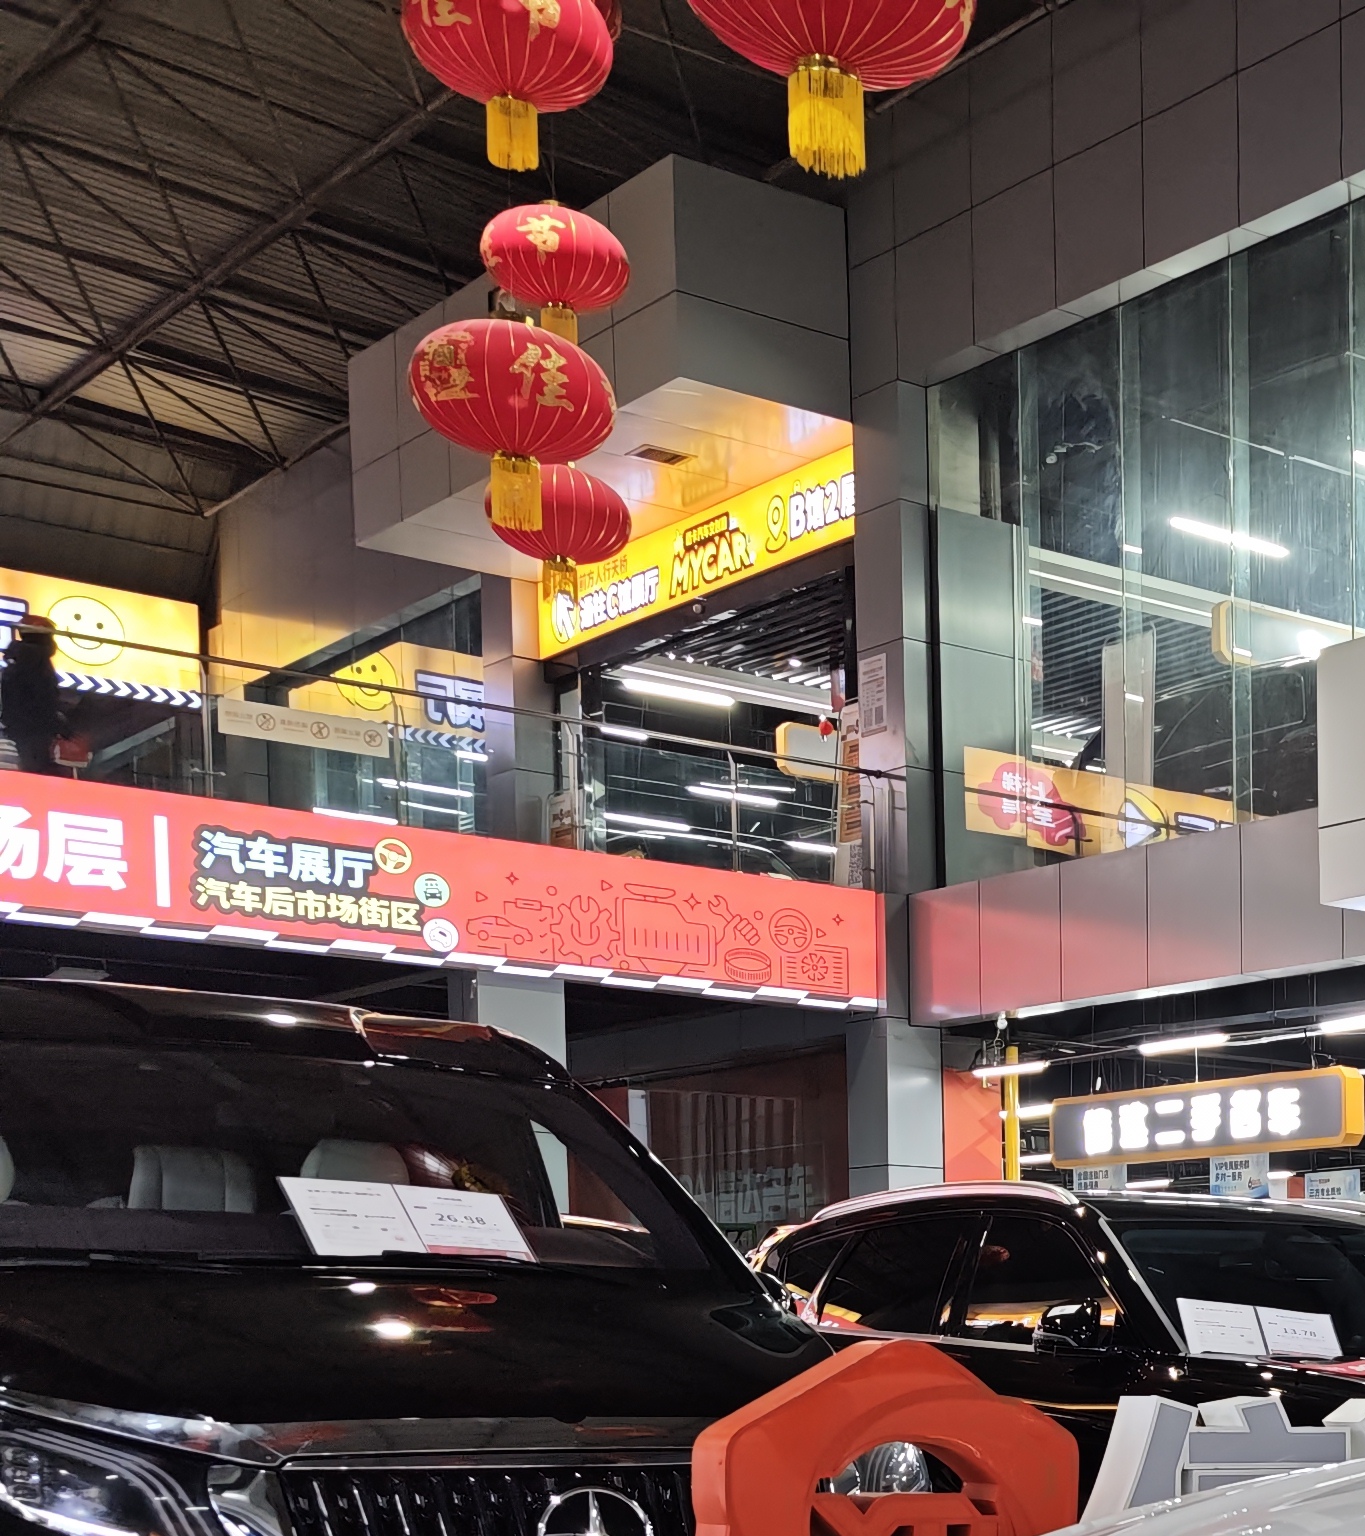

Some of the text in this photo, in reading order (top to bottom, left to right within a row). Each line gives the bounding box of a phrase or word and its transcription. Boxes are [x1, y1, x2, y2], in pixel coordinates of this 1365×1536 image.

[669, 532, 752, 598] MYCAR
[199, 831, 374, 889] 汽车展厅
[197, 877, 422, 932] 汽车后市场街区
[1083, 1087, 1301, 1156] 二手名车
